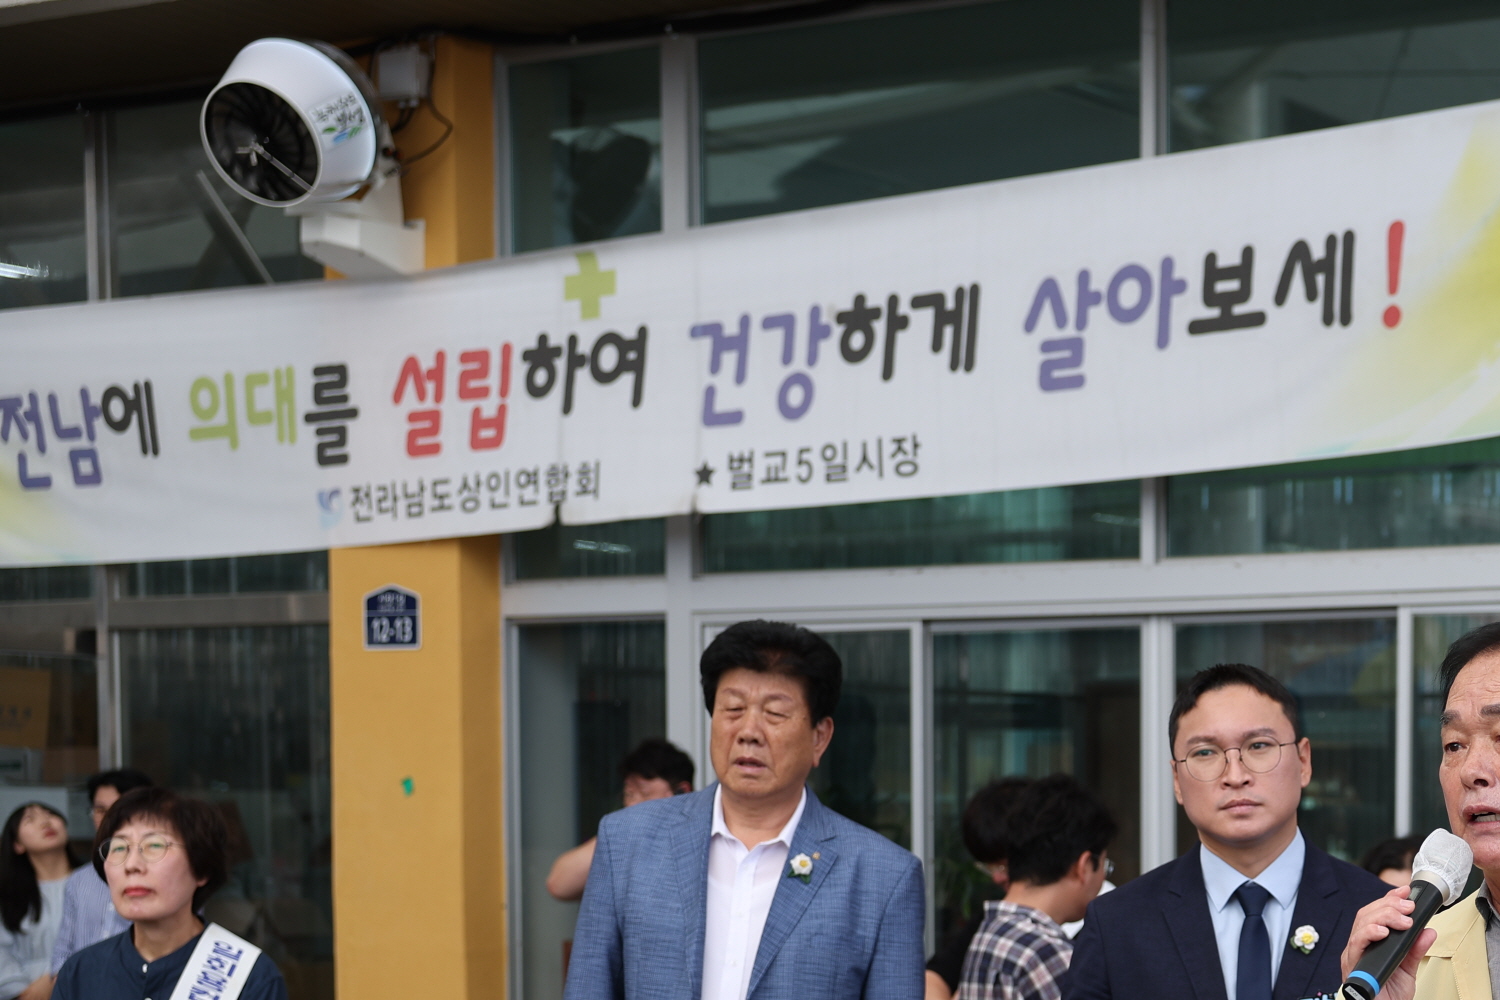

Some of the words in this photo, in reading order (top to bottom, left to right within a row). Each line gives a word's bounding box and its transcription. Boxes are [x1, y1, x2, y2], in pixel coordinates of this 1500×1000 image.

[0, 379, 160, 490] 전남에
[188, 363, 360, 467] 의대를
[392, 324, 649, 459] 설립하여
[690, 283, 980, 428] 건강하게
[347, 459, 602, 525] 전라남도상인연합회
